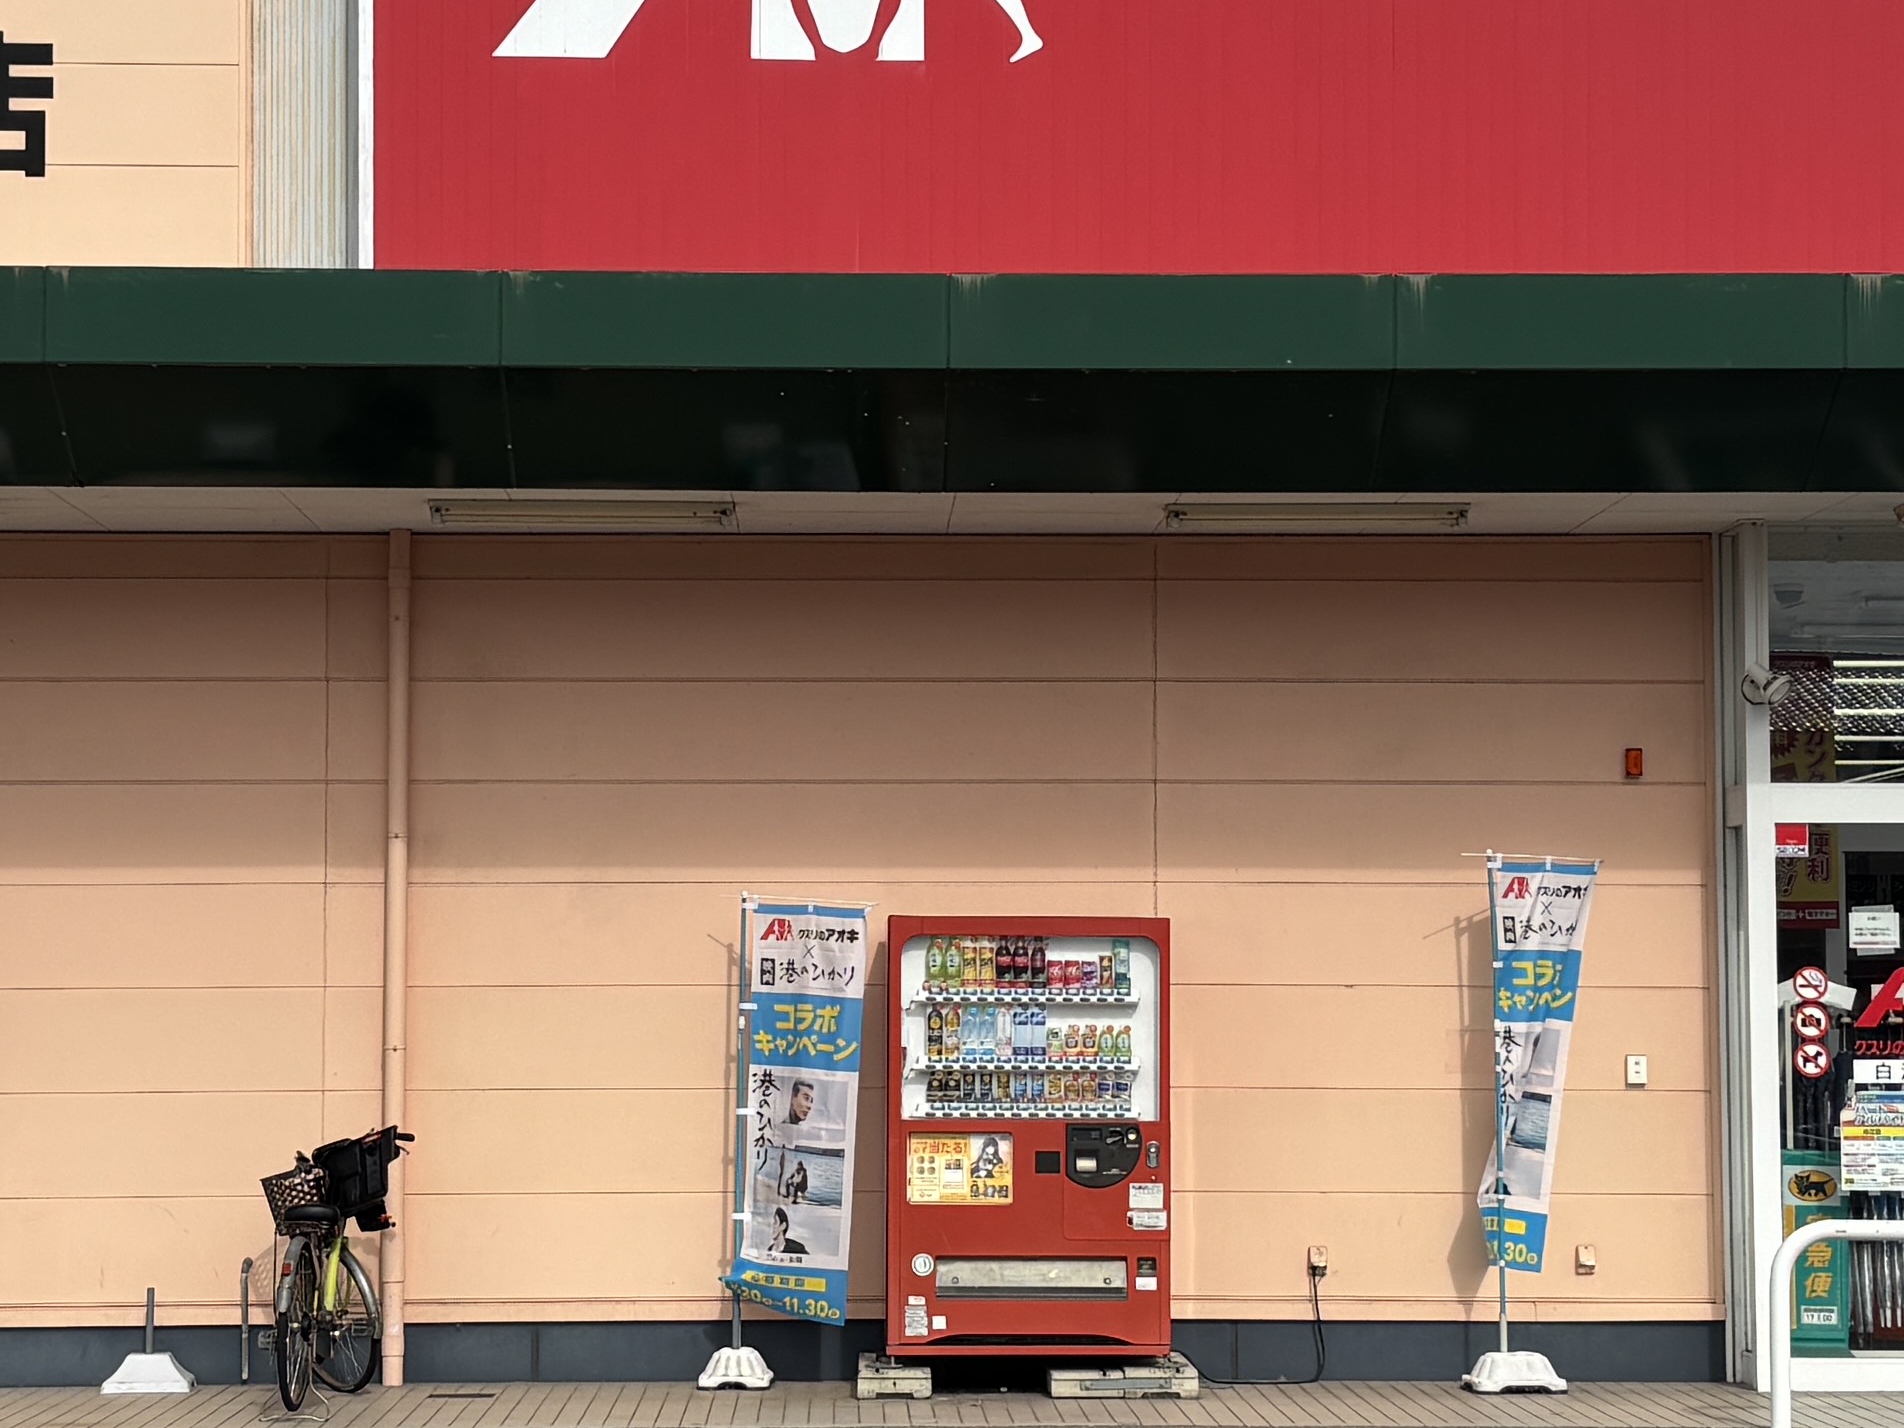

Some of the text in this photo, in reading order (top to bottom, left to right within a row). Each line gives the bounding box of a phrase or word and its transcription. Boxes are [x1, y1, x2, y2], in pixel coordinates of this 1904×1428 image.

[798, 928, 859, 944] クスリのアオキ
[779, 958, 855, 986] 港のひかり
[774, 1004, 841, 1033] コラボ
[753, 1030, 859, 1061] キャンペーン
[752, 1068, 781, 1171] 港のひかり
